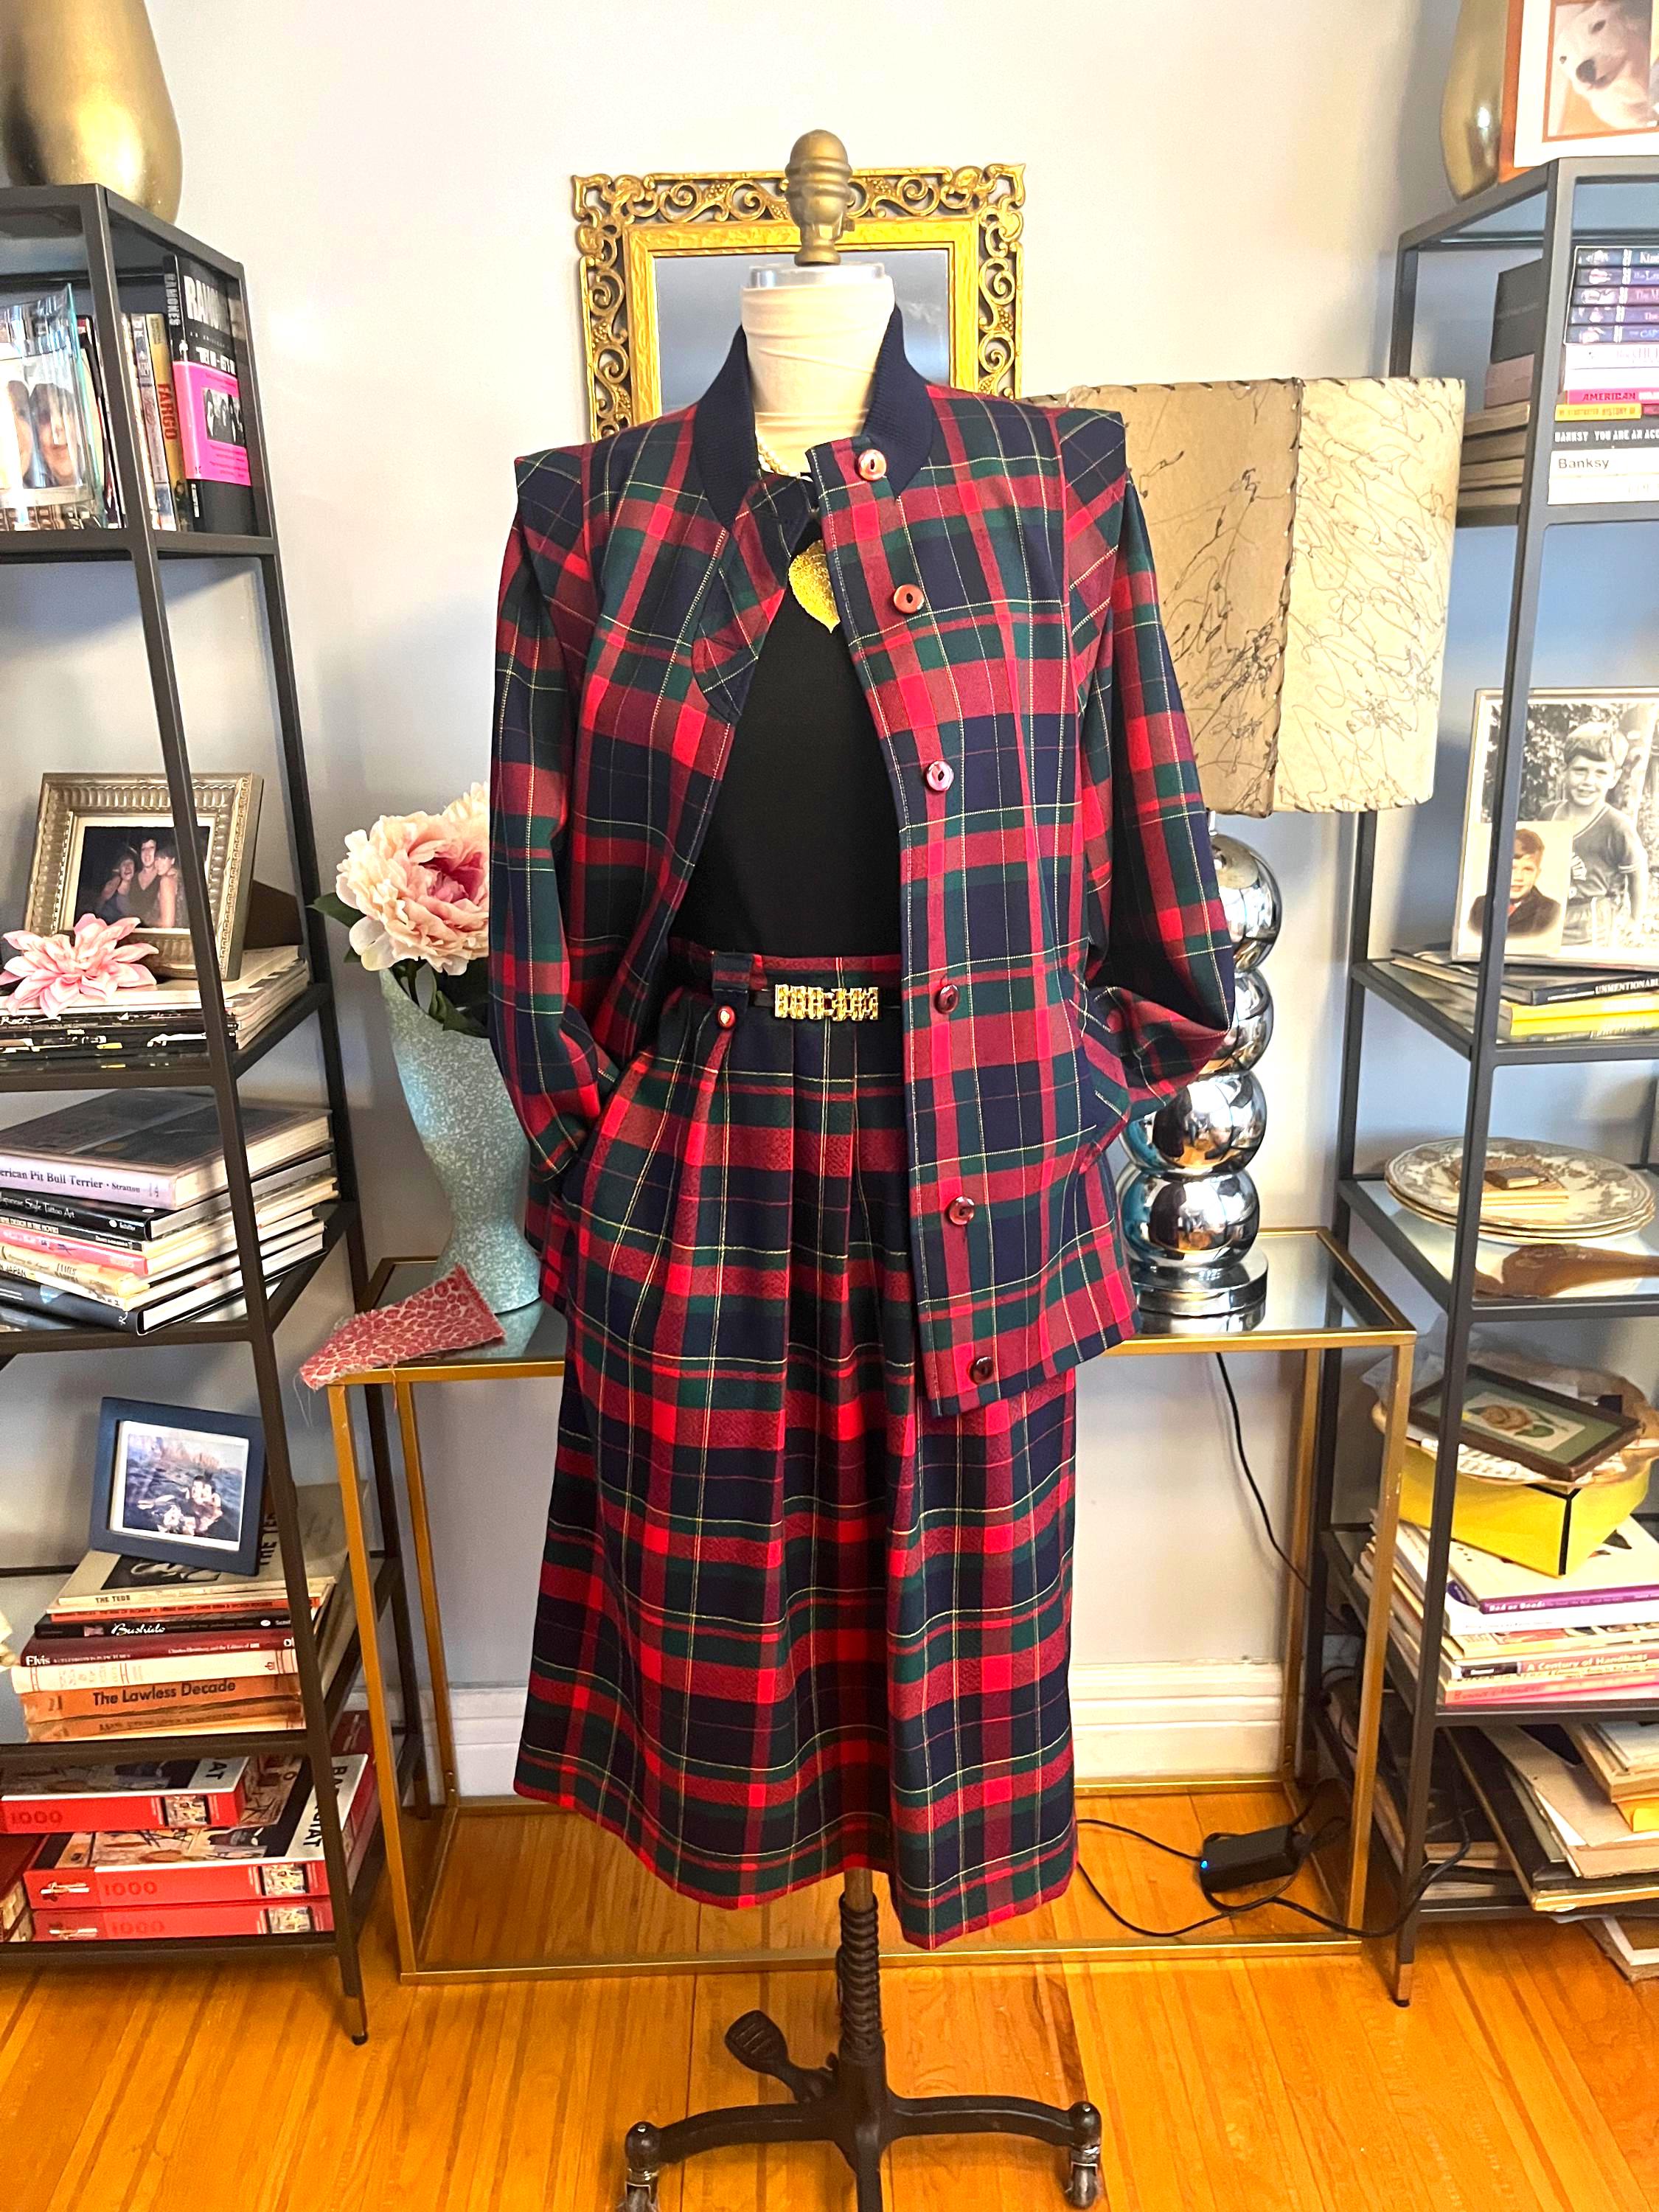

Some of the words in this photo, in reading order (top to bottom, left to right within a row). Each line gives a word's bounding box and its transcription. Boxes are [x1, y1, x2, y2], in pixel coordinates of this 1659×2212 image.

[1582, 392, 1635, 401] AMERICAN
[158, 383, 178, 439] FARGO
[1554, 431, 1588, 442] BANKSY
[1594, 431, 1611, 441] YOU
[1613, 429, 1630, 440] ARE
[1558, 458, 1609, 469] Banksy
[0, 1168, 27, 1180] erican
[30, 1170, 44, 1181] Pit
[47, 1172, 66, 1184] Bull
[69, 1175, 103, 1189] Terrier
[112, 1183, 141, 1193] Stratton
[43, 1202, 63, 1215] Tattoo
[64, 1208, 75, 1219] Art
[111, 1623, 166, 1636] Bushido
[26, 1655, 50, 1666] Elvis
[1539, 1660, 1579, 1670] Century
[1582, 1658, 1593, 1666] of
[1596, 1654, 1647, 1665] Handbags
[93, 1691, 118, 1706] The
[122, 1686, 177, 1703] Lawless
[181, 1677, 236, 1697] Decade
[11, 1811, 63, 1824] 1000
[105, 1881, 158, 1896] 1000
